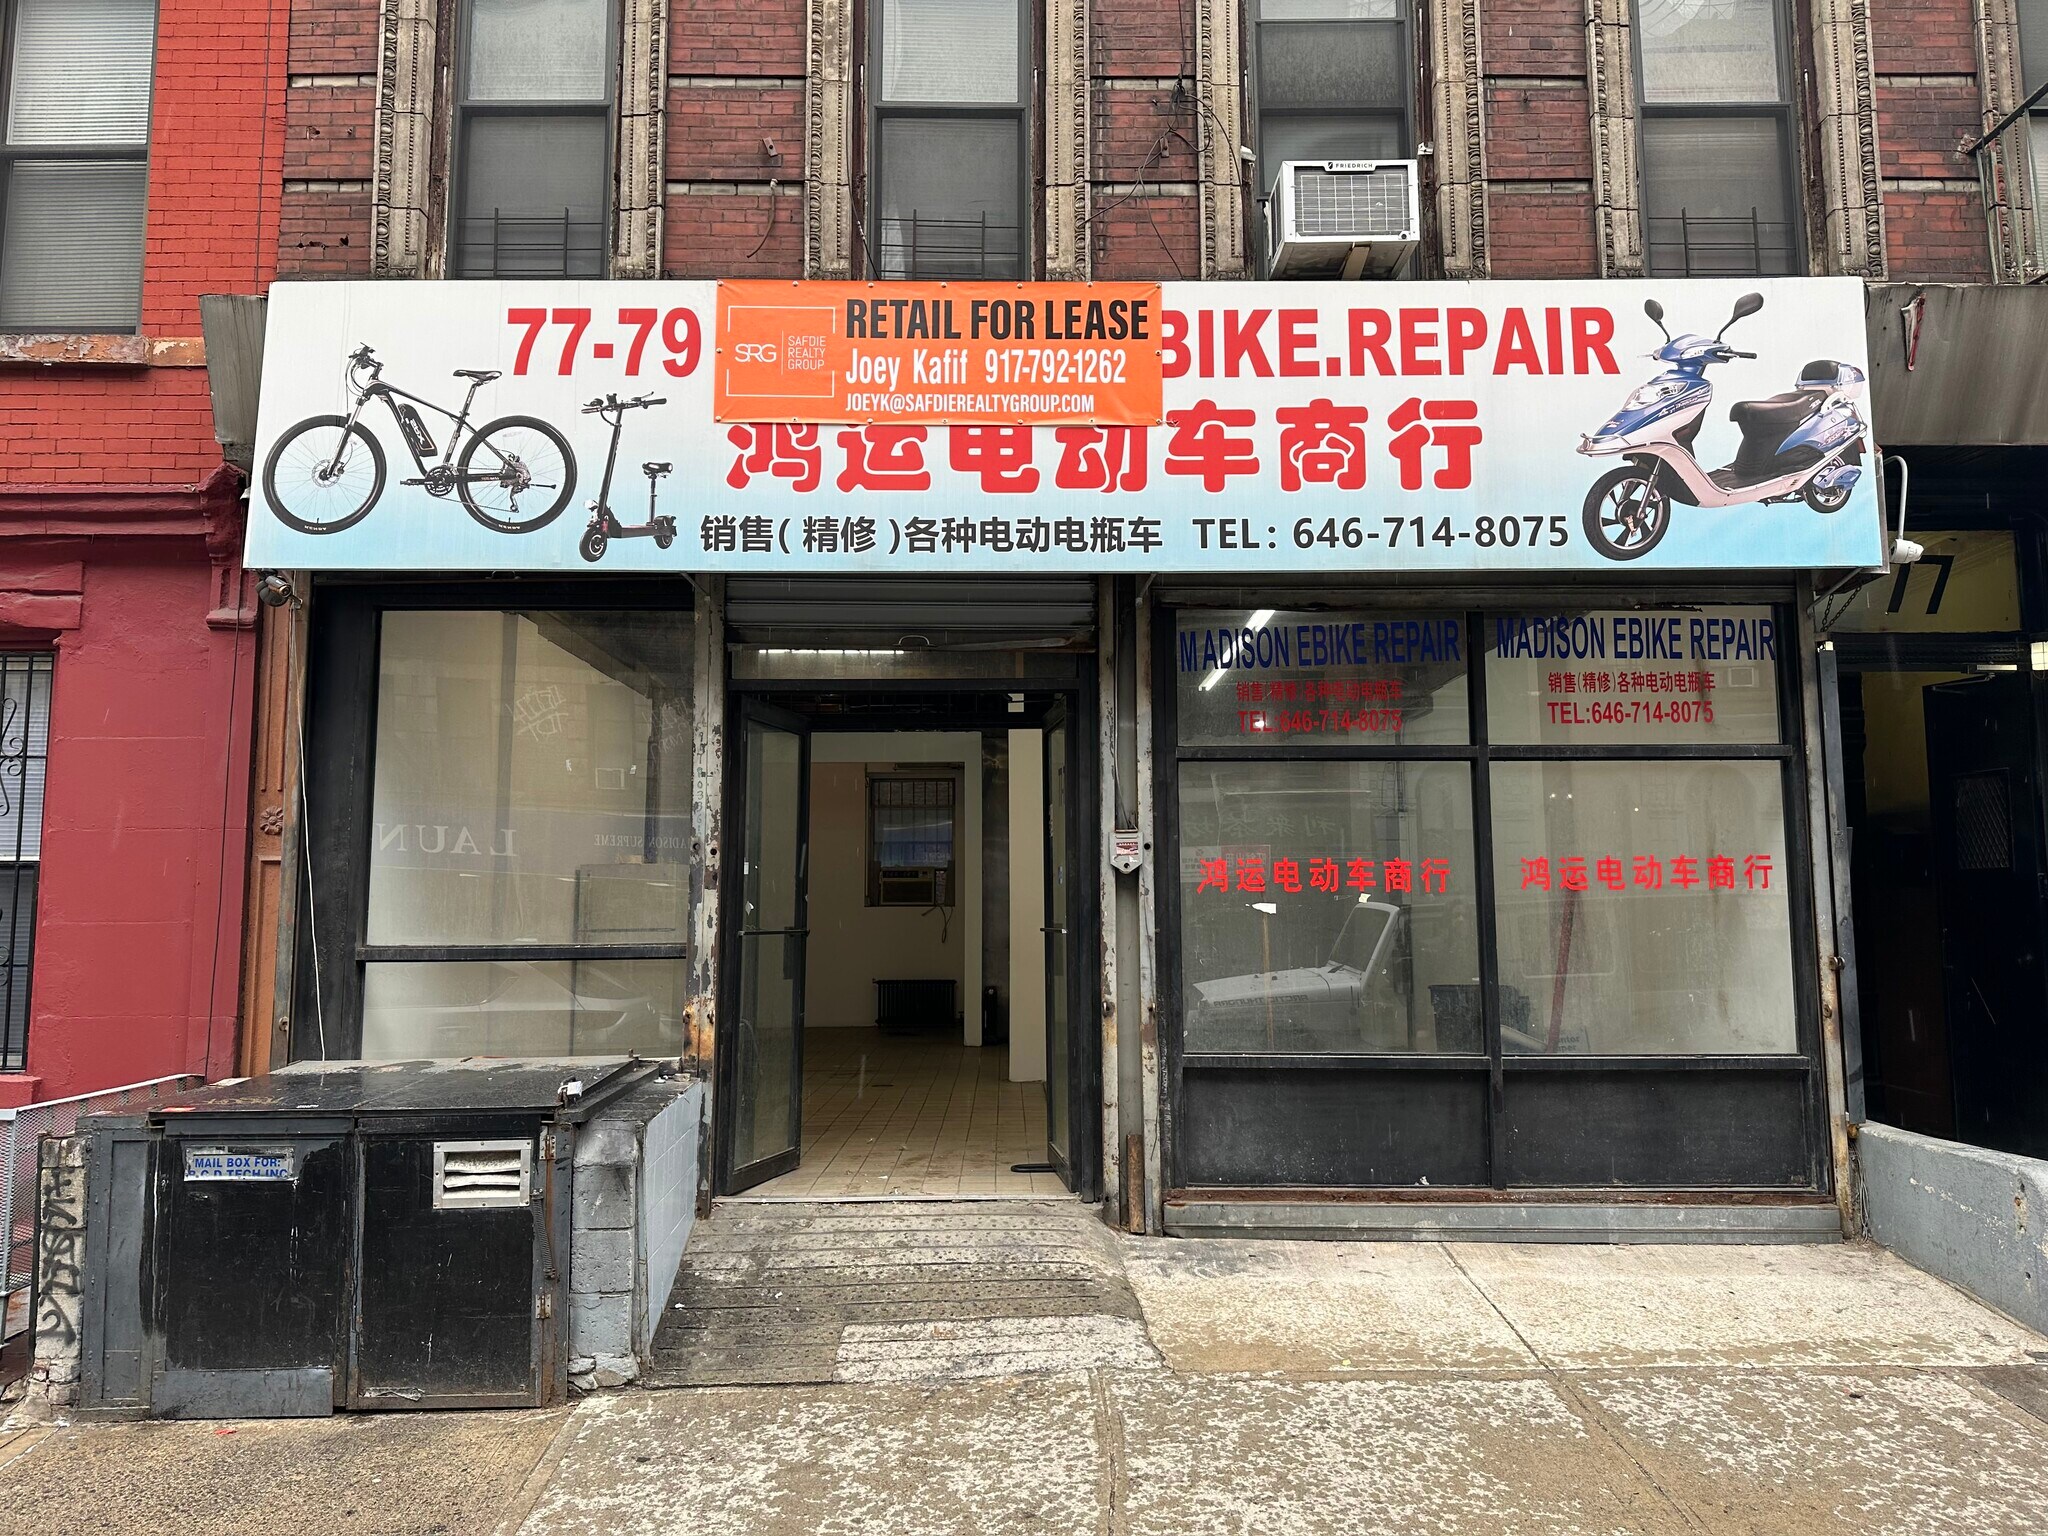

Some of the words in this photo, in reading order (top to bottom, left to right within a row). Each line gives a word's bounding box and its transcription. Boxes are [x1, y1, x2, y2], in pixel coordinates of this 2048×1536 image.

[846, 299, 961, 340] RETAIL
[971, 299, 1035, 340] FOR
[1046, 300, 1148, 340] LEASE
[506, 307, 702, 377] 77-79
[735, 343, 777, 363] SRG
[787, 335, 827, 347] SAFDIE
[787, 347, 826, 359] REALTY
[787, 358, 825, 370] GROUP
[846, 348, 900, 391] Joey
[913, 348, 968, 384] Kafif
[985, 349, 1126, 384] 917-792-1262
[845, 394, 1094, 413] JOEYK@SAFDIEREALTYGROUP.COM
[726, 397, 1483, 493] 鸿运电动车商行
[1293, 516, 1569, 549] 646-714-8075
[1180, 626, 1290, 672] MADISON
[1297, 623, 1367, 666] EBIKE
[1374, 620, 1461, 664] REPAIR
[1496, 617, 1605, 659] MADISON
[1612, 618, 1683, 660] EBIKE
[1690, 618, 1776, 661] REPAIR
[1547, 700, 1714, 724] TEL:646-714-8075
[1197, 856, 1450, 893] 鸿运电动车商行
[1520, 854, 1773, 891] 鸿运电动车商行
[194, 1157, 223, 1168] MAIL
[226, 1157, 251, 1168] BOX
[254, 1156, 281, 1167] FOR:
